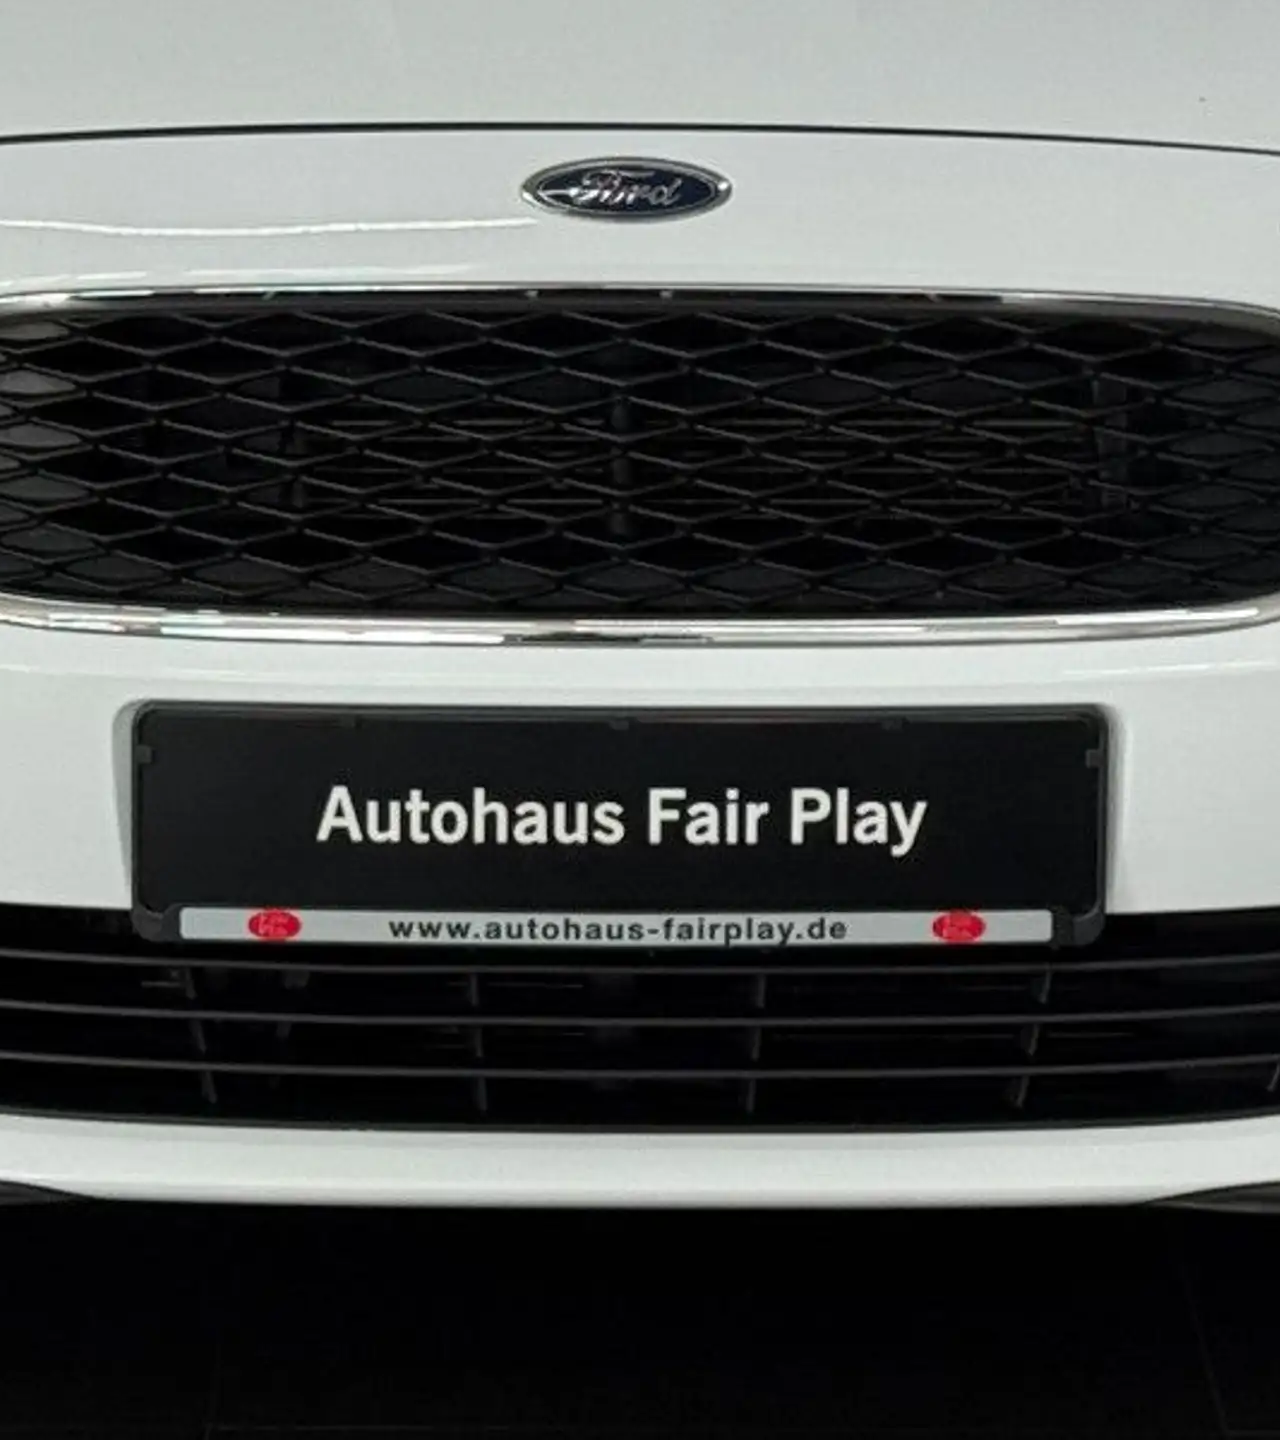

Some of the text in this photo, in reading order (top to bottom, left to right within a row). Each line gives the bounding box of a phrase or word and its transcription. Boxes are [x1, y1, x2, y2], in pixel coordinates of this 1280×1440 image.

[566, 168, 683, 206] Ford
[315, 785, 927, 857] Autohaus Fair Play
[388, 917, 848, 945] www.autohaus-fairplay.de
